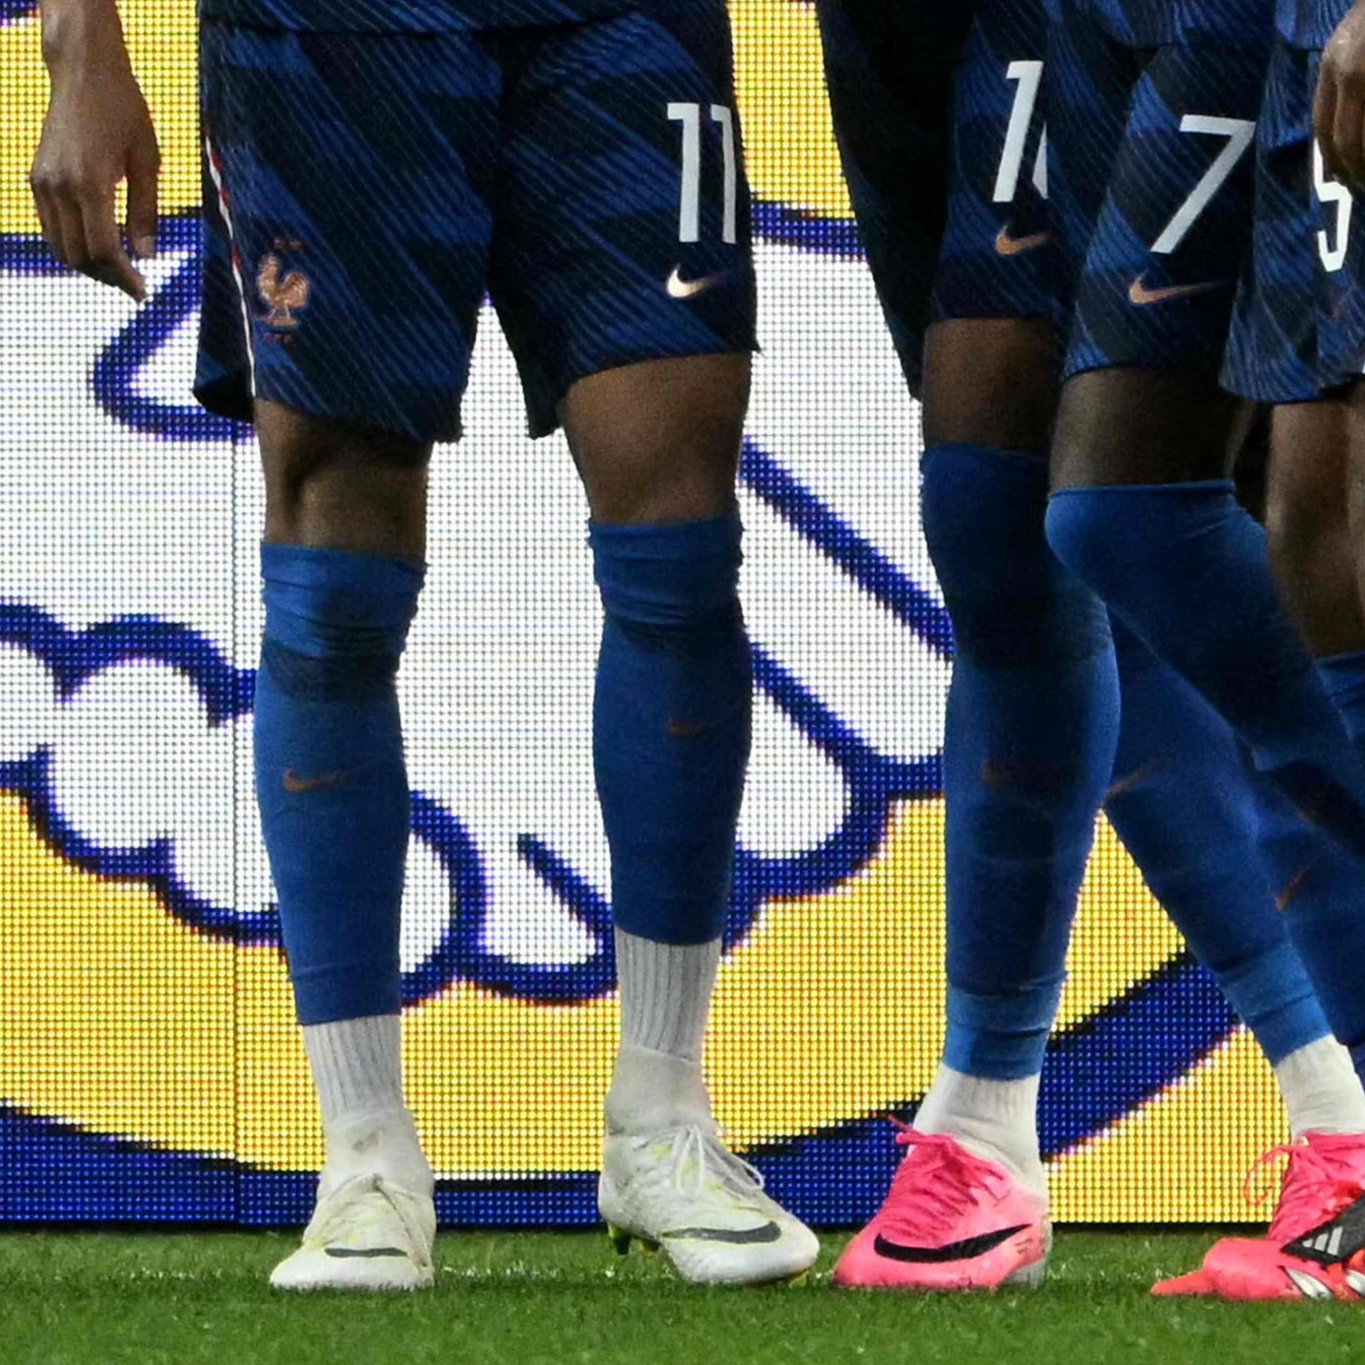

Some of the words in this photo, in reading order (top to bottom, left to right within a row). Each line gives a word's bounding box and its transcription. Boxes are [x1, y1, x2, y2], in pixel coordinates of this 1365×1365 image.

[666, 101, 737, 245] 11
[1150, 114, 1256, 254] 7
[1313, 137, 1353, 272] 5
